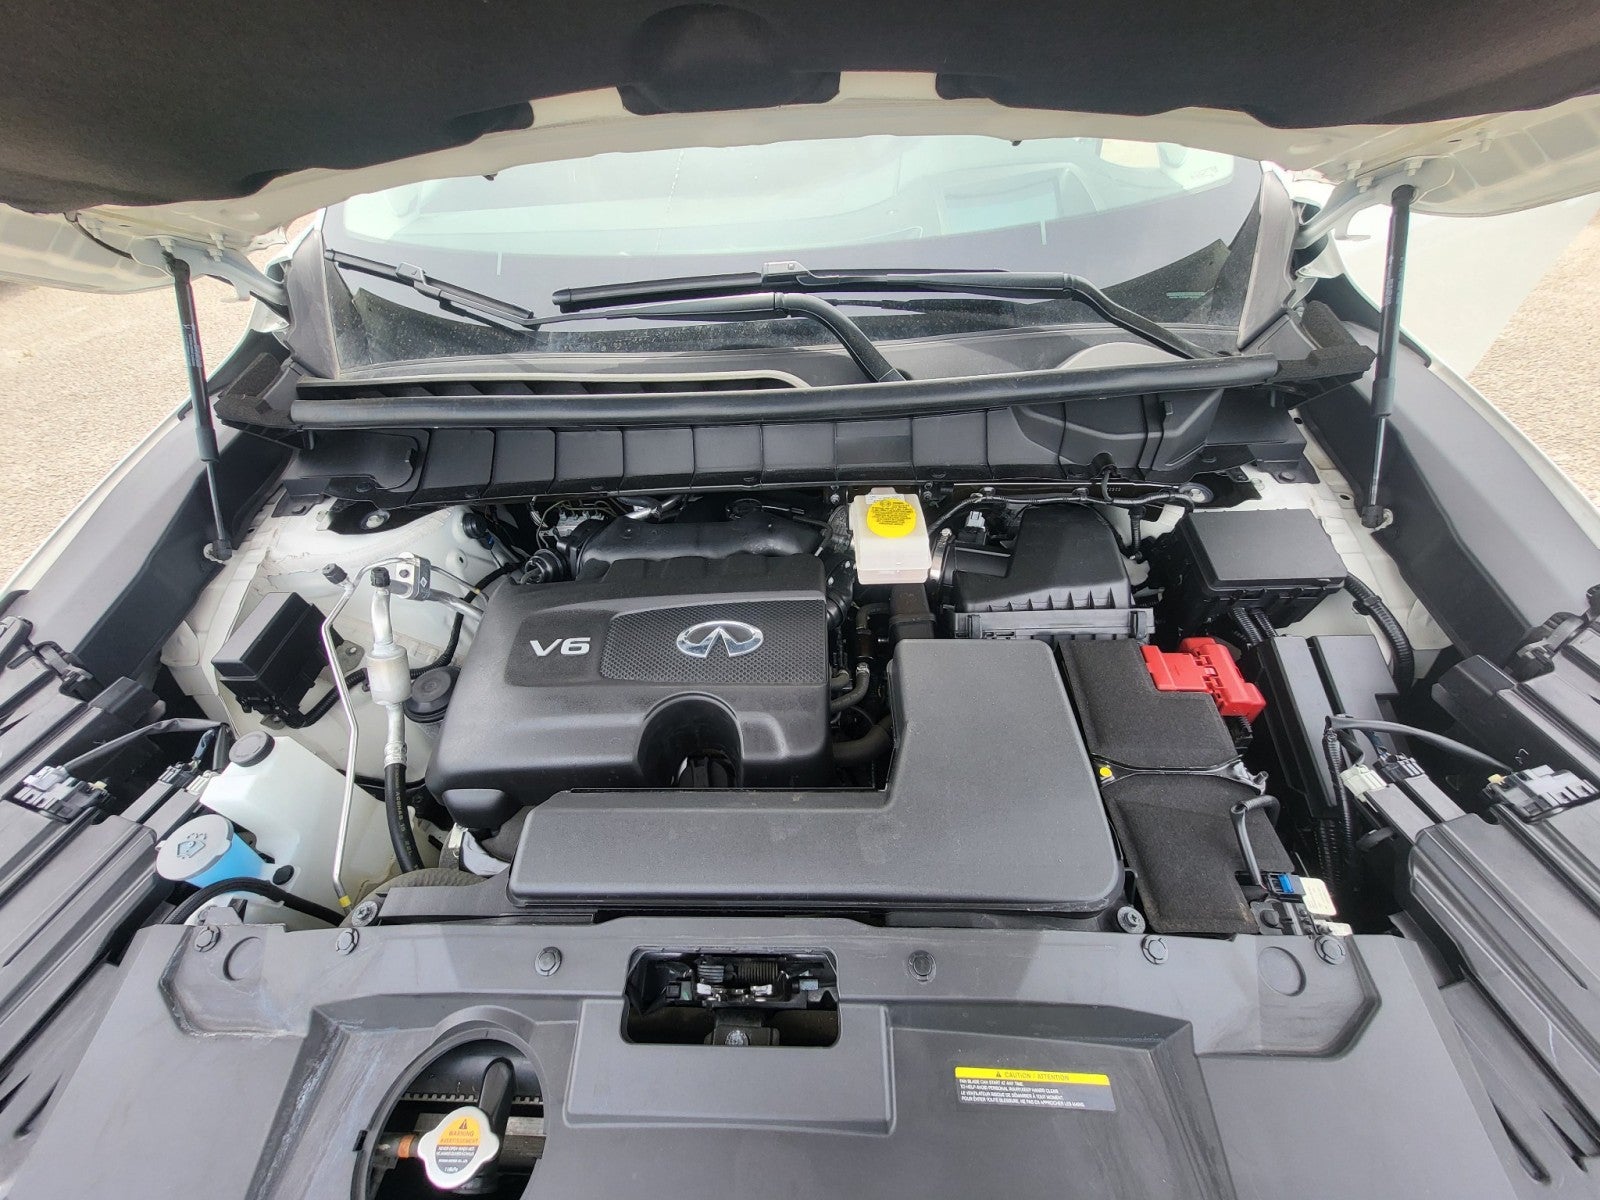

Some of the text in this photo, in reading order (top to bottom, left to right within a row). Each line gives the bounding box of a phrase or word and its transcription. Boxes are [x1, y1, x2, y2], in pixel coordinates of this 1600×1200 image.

[529, 637, 591, 657] V6
[1004, 1071, 1031, 1079] CAUTION
[1037, 1073, 1069, 1081] ATTENTION
